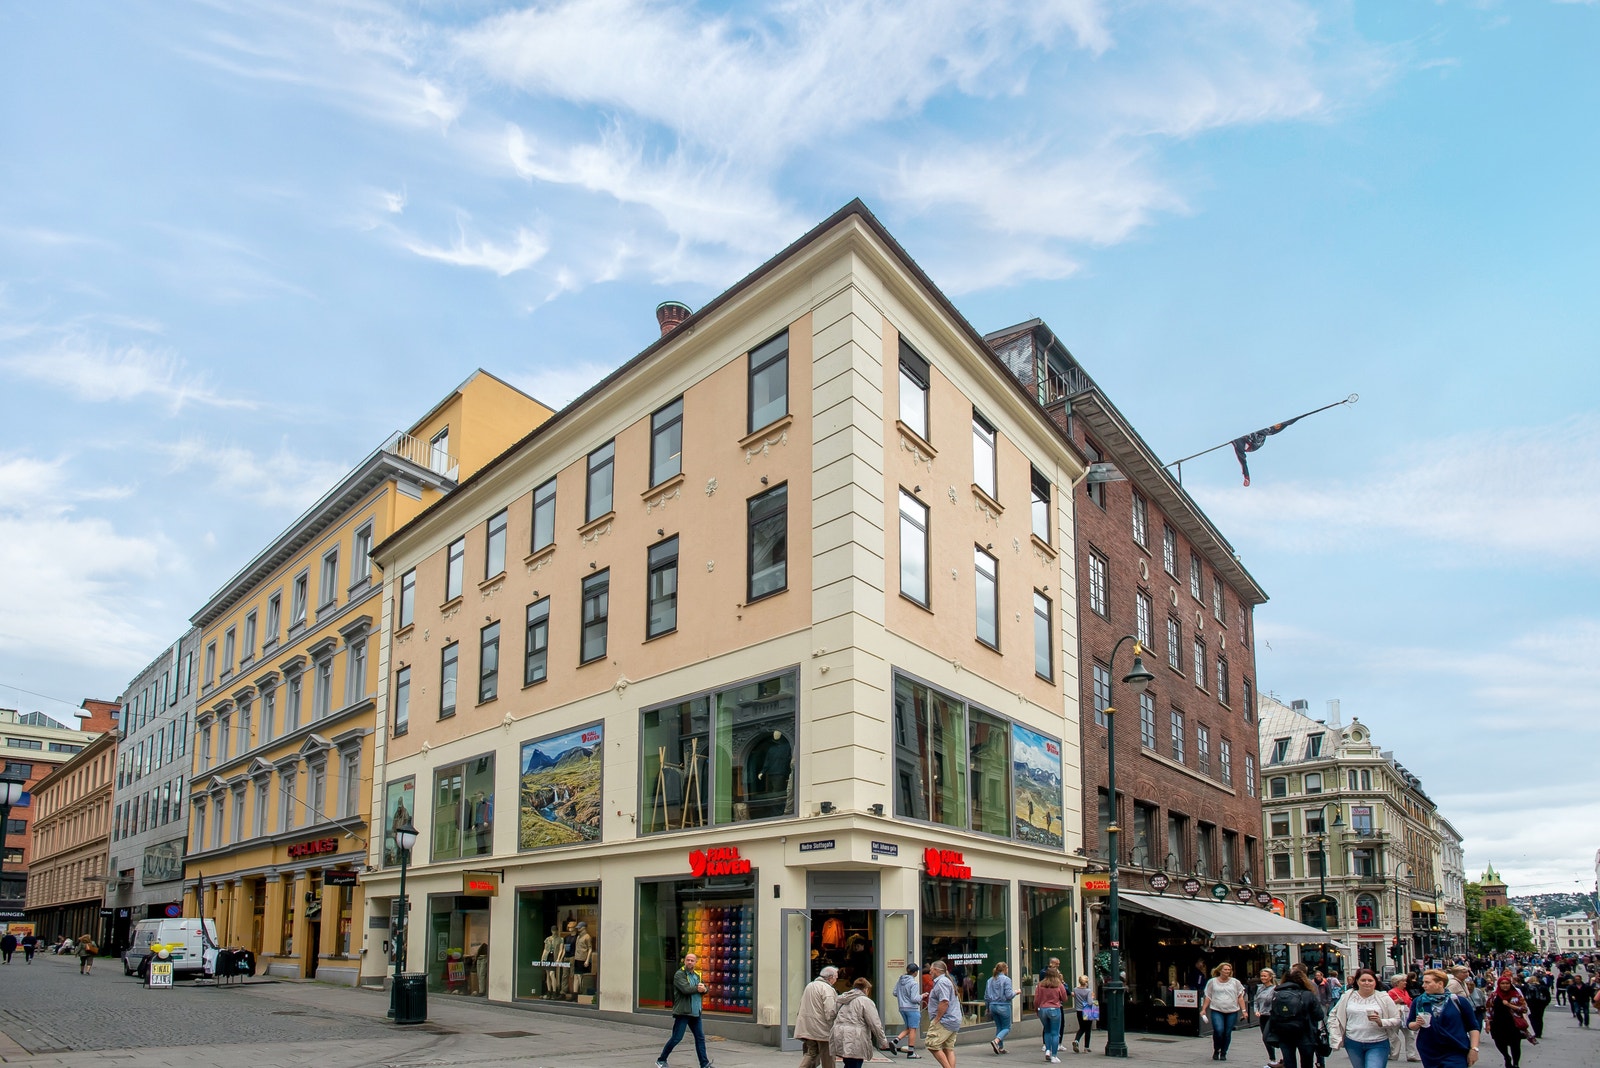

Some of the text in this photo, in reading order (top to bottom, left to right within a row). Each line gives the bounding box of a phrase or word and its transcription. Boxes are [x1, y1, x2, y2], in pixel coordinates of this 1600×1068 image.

[288, 838, 338, 857] CARLINGS
[153, 963, 170, 974] FINAL
[153, 975, 170, 984] SALE
